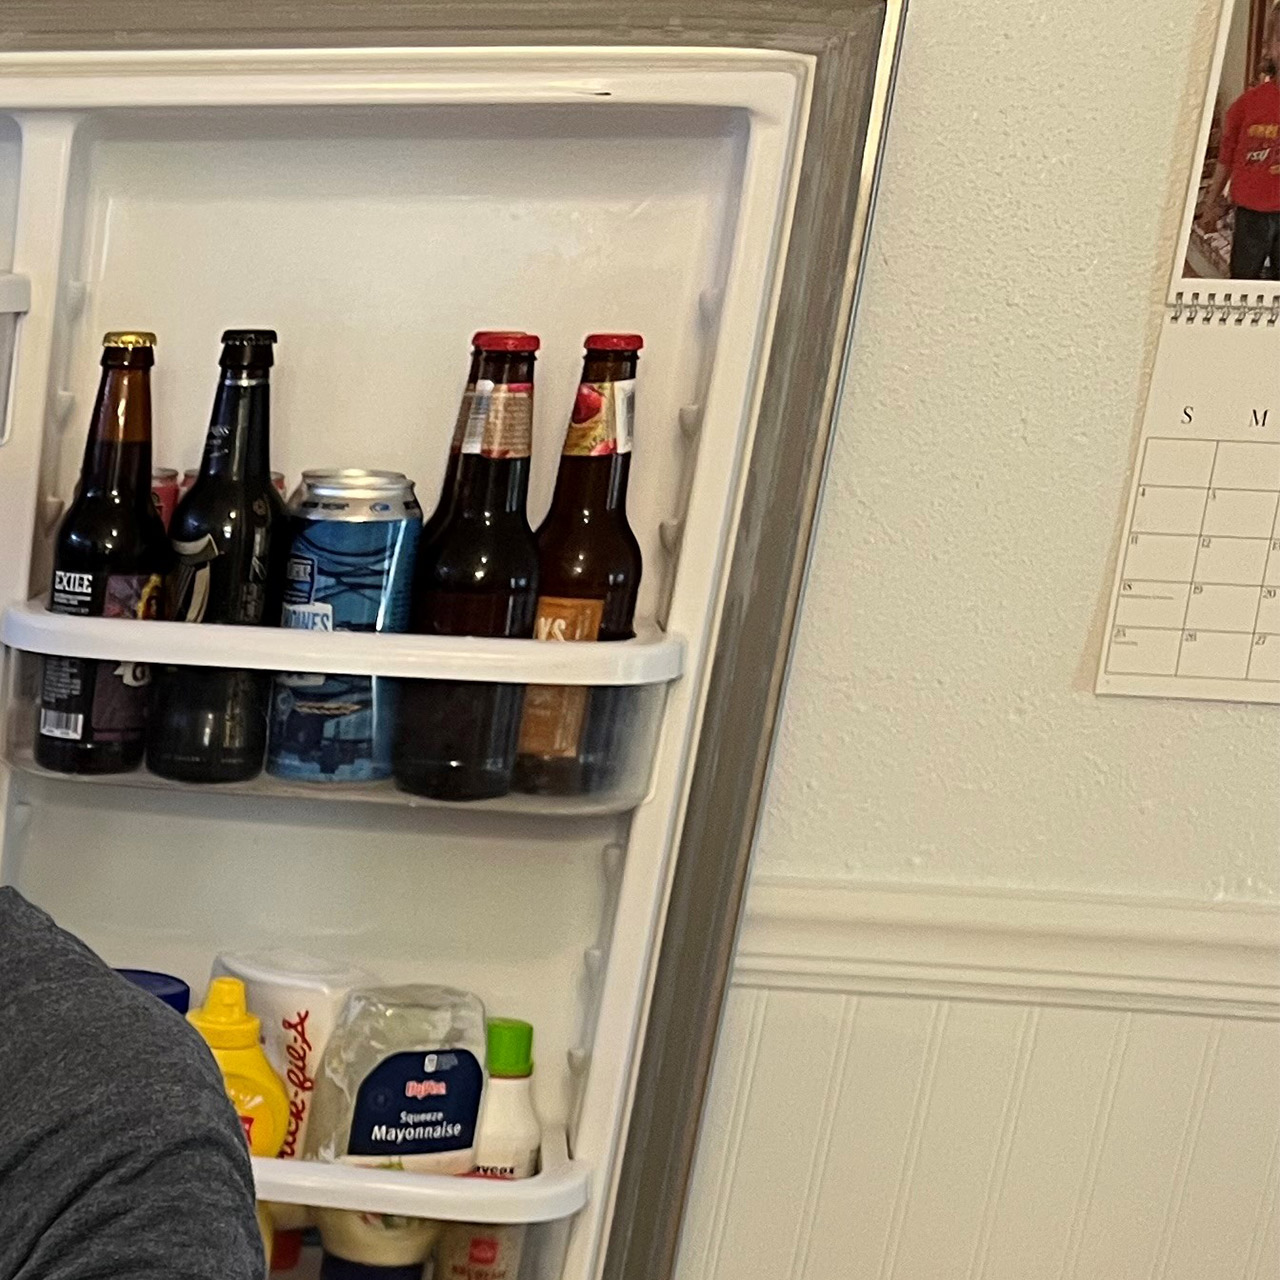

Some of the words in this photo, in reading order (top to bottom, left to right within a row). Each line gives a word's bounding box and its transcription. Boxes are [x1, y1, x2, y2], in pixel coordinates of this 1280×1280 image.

[1180, 405, 1194, 425] S
[1248, 408, 1269, 428] M
[399, 1110, 444, 1126] Squeeze
[370, 1120, 462, 1145] Mayonnaise
